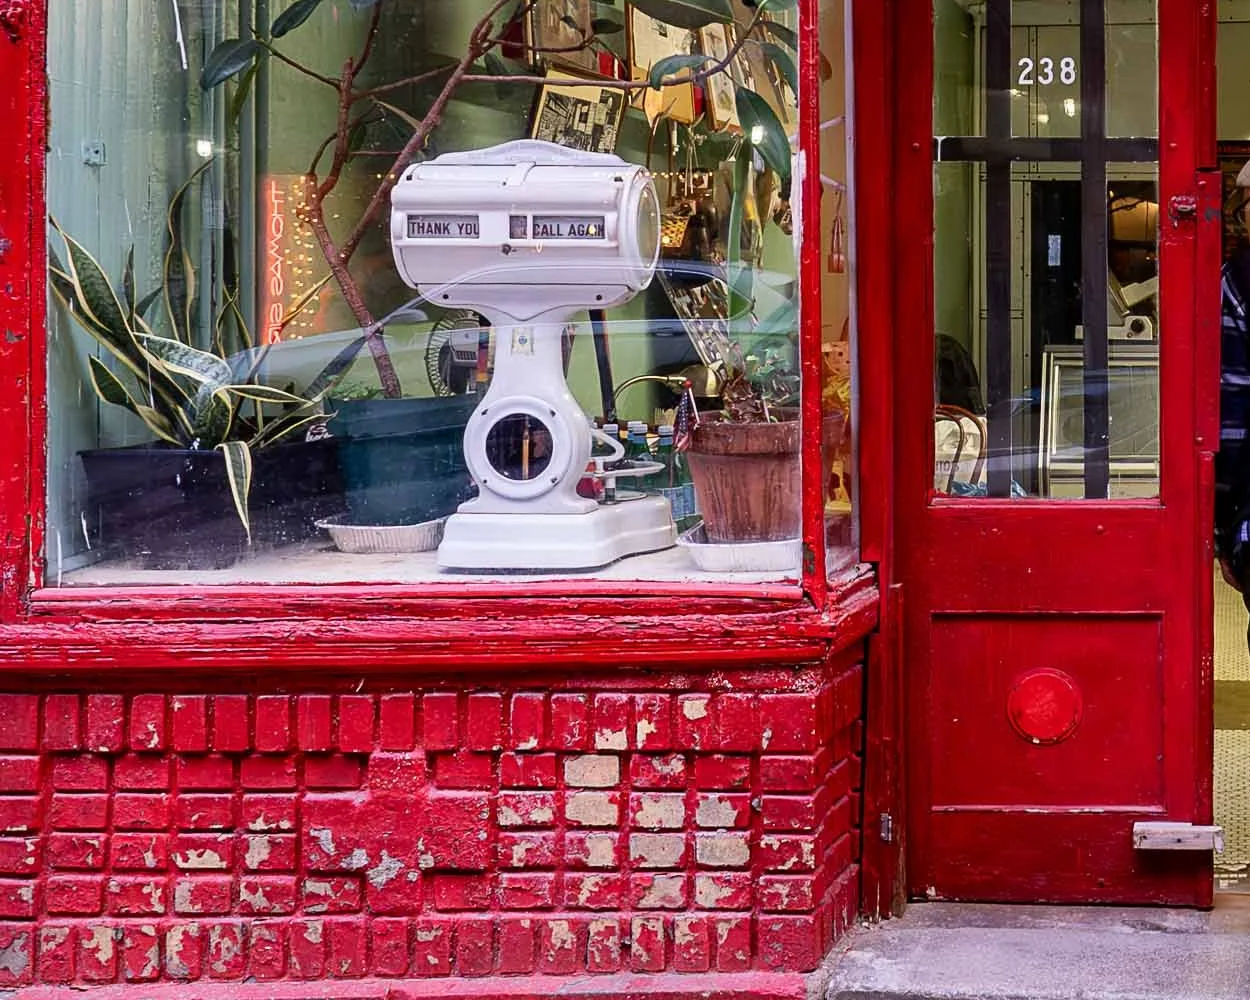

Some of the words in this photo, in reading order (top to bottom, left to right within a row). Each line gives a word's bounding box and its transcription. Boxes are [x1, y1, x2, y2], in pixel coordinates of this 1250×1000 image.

[1018, 57, 1076, 85] 238
[410, 222, 450, 235] THANK
[457, 222, 479, 235] YOU
[533, 223, 564, 237] CALL
